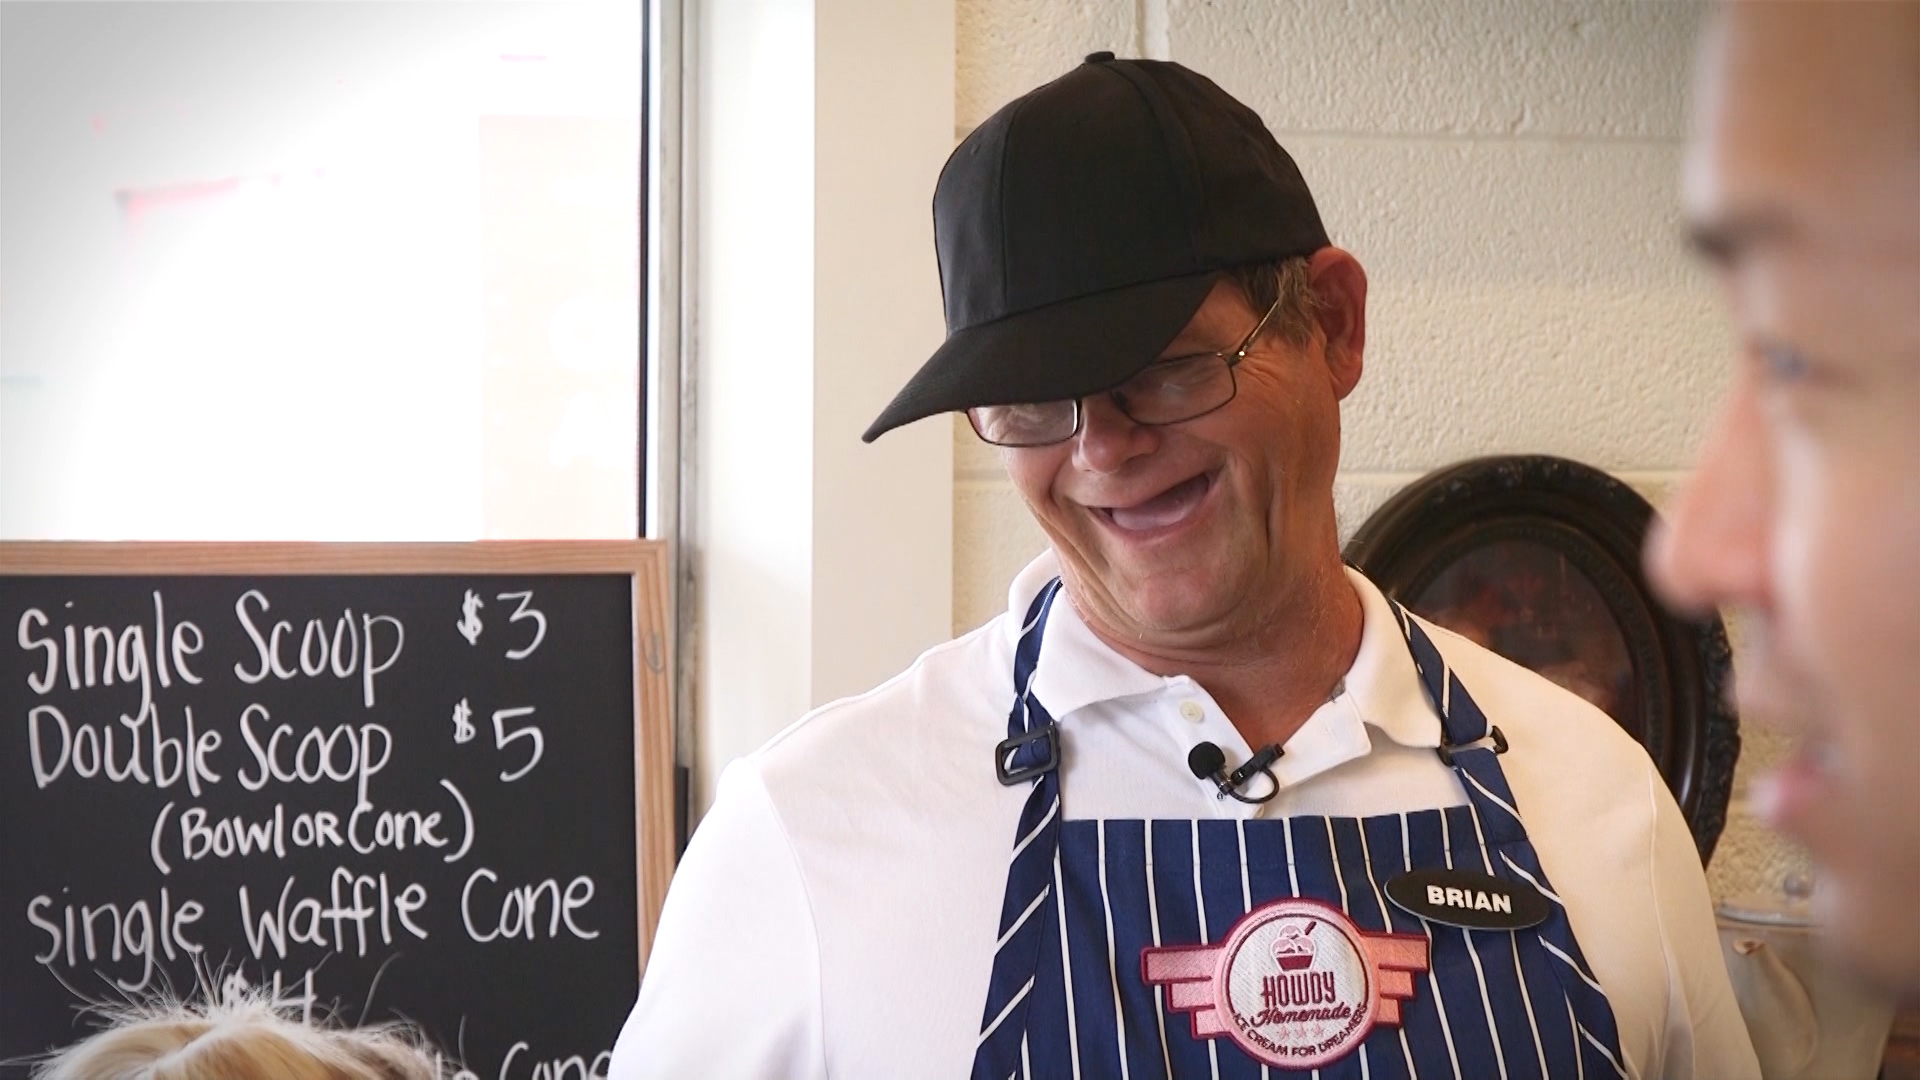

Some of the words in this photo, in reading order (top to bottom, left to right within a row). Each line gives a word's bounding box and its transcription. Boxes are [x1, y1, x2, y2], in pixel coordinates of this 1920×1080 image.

[17, 590, 204, 724] Single
[234, 589, 404, 707] Scoop
[28, 703, 222, 796] Double
[237, 703, 393, 810] Scoop
[1427, 884, 1512, 914] BRIAN
[26, 887, 204, 992] Single
[239, 866, 428, 960] Waffle
[461, 867, 600, 942] Cone
[1251, 1001, 1351, 1028] Homemade
[1261, 971, 1336, 1009] HOWDY
[1233, 1012, 1251, 1032] ICE
[1247, 1030, 1289, 1056] CREAM
[1291, 1045, 1317, 1057] FOR
[1318, 1001, 1368, 1055] DREAMERS
